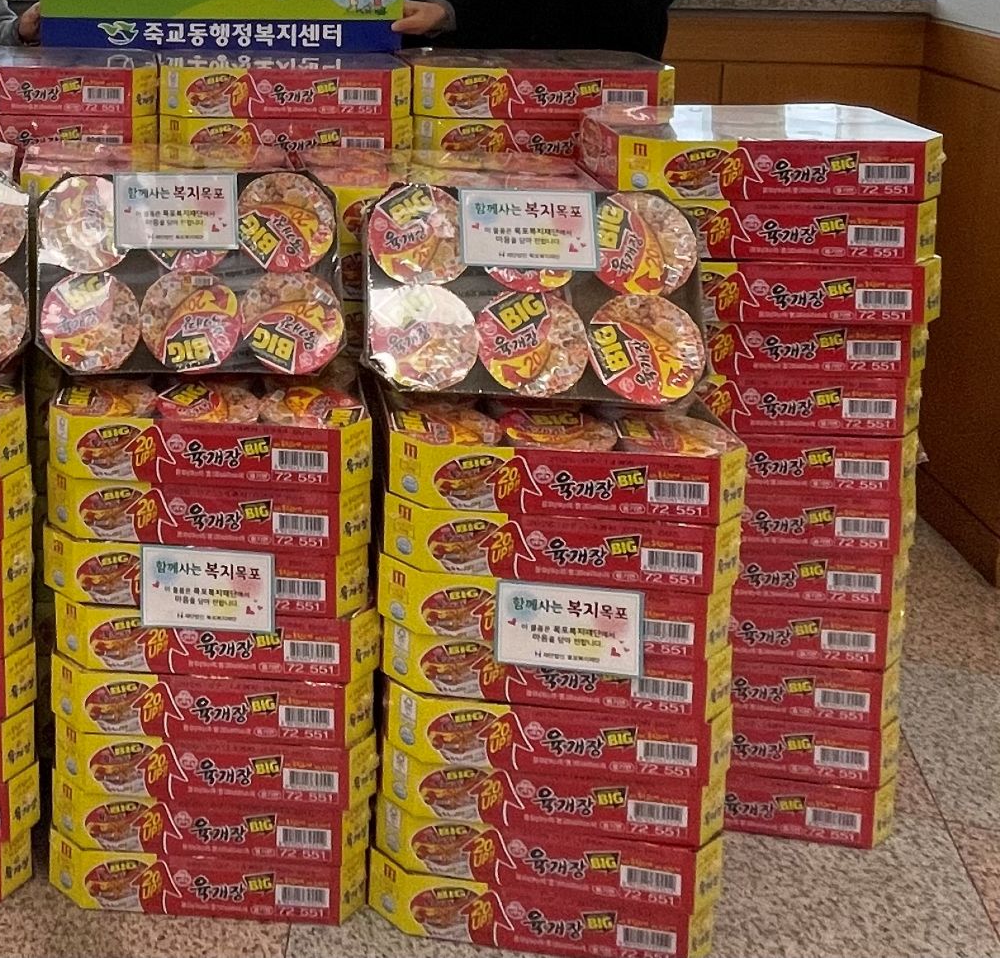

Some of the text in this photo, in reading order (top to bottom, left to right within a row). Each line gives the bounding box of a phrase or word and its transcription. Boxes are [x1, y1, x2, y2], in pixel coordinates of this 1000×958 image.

[143, 22, 342, 47] 죽교동행정복지센터
[18, 80, 80, 100] 육개장 BIG
[272, 83, 336, 104] 육개장 BIG
[533, 85, 600, 106] 육개장 BIG
[772, 156, 856, 185] 육개장 BIG
[174, 186, 224, 200] 복지목포
[862, 186, 909, 194] 72 551
[389, 192, 432, 224] BIG
[475, 202, 582, 218] 함께사는 복지목포
[761, 216, 846, 246] 육개장 BIG
[770, 281, 853, 310] 육개장 BIG
[499, 296, 545, 330] BIG
[168, 339, 212, 363] BIG
[252, 327, 294, 359] BIG
[494, 327, 538, 355] 육개장
[594, 326, 622, 372] BIG
[762, 333, 844, 361] 육개장 BIG
[186, 441, 242, 467] 육개장
[244, 441, 268, 455] BIG
[276, 473, 322, 482] 72 551
[552, 472, 644, 500] 육개장 BIG
[186, 504, 270, 530] 육개장 BIG
[650, 506, 702, 516] 72 551
[544, 538, 637, 566] 육개장 BIG
[156, 561, 260, 580] 함께사는 복지목포
[513, 596, 628, 620] 함께사는 복지목포
[198, 633, 280, 658] 육개장 BIG
[193, 698, 275, 723] 육개장 BIG
[542, 728, 633, 756] 육개장 BIG
[197, 760, 279, 785] 육개장 BIG
[533, 786, 624, 815] 육개장 BIG
[191, 818, 273, 843] 육개장 BIG
[525, 848, 616, 879] 육개장 BIG
[192, 877, 271, 901] 육개장 BIG
[523, 909, 612, 938] 육개장 BIG
